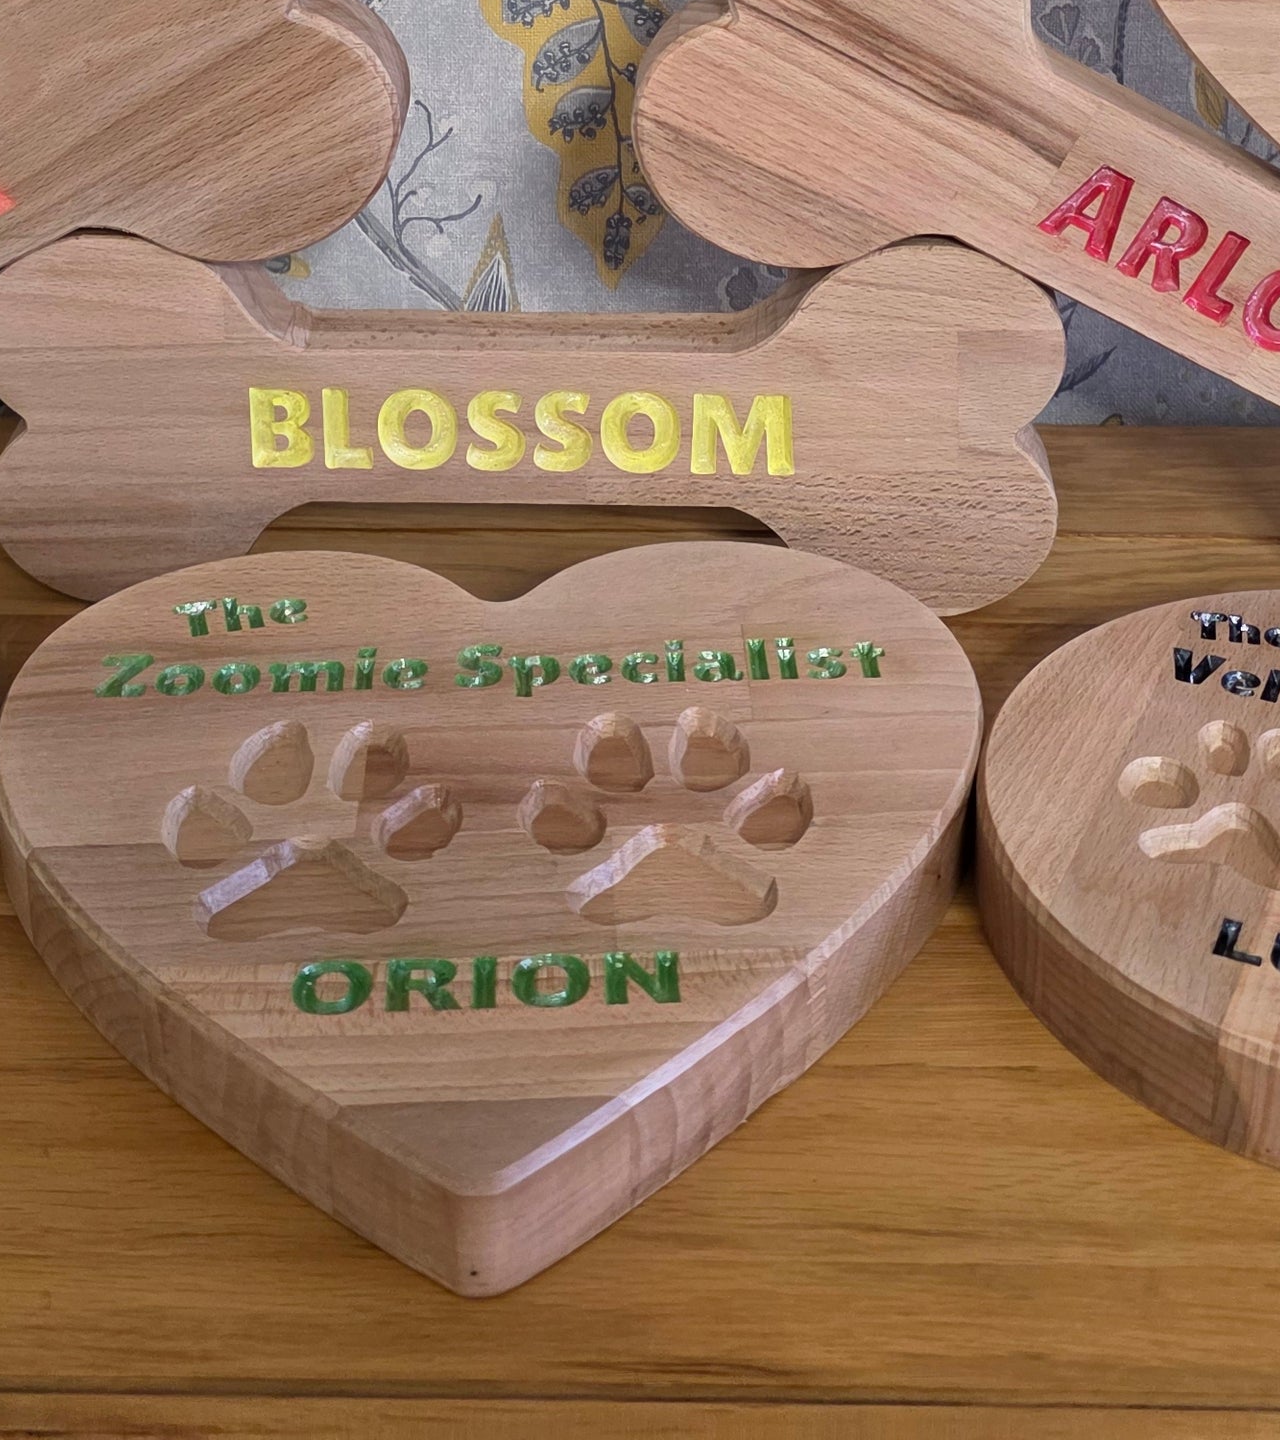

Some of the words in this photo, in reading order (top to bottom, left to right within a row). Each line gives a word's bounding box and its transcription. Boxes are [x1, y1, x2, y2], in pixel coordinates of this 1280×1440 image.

[248, 387, 795, 476] BLOSSOM
[172, 597, 308, 637] The
[94, 646, 428, 698] Zoomie
[457, 637, 885, 698] Specialist
[291, 951, 682, 1016] ORION
